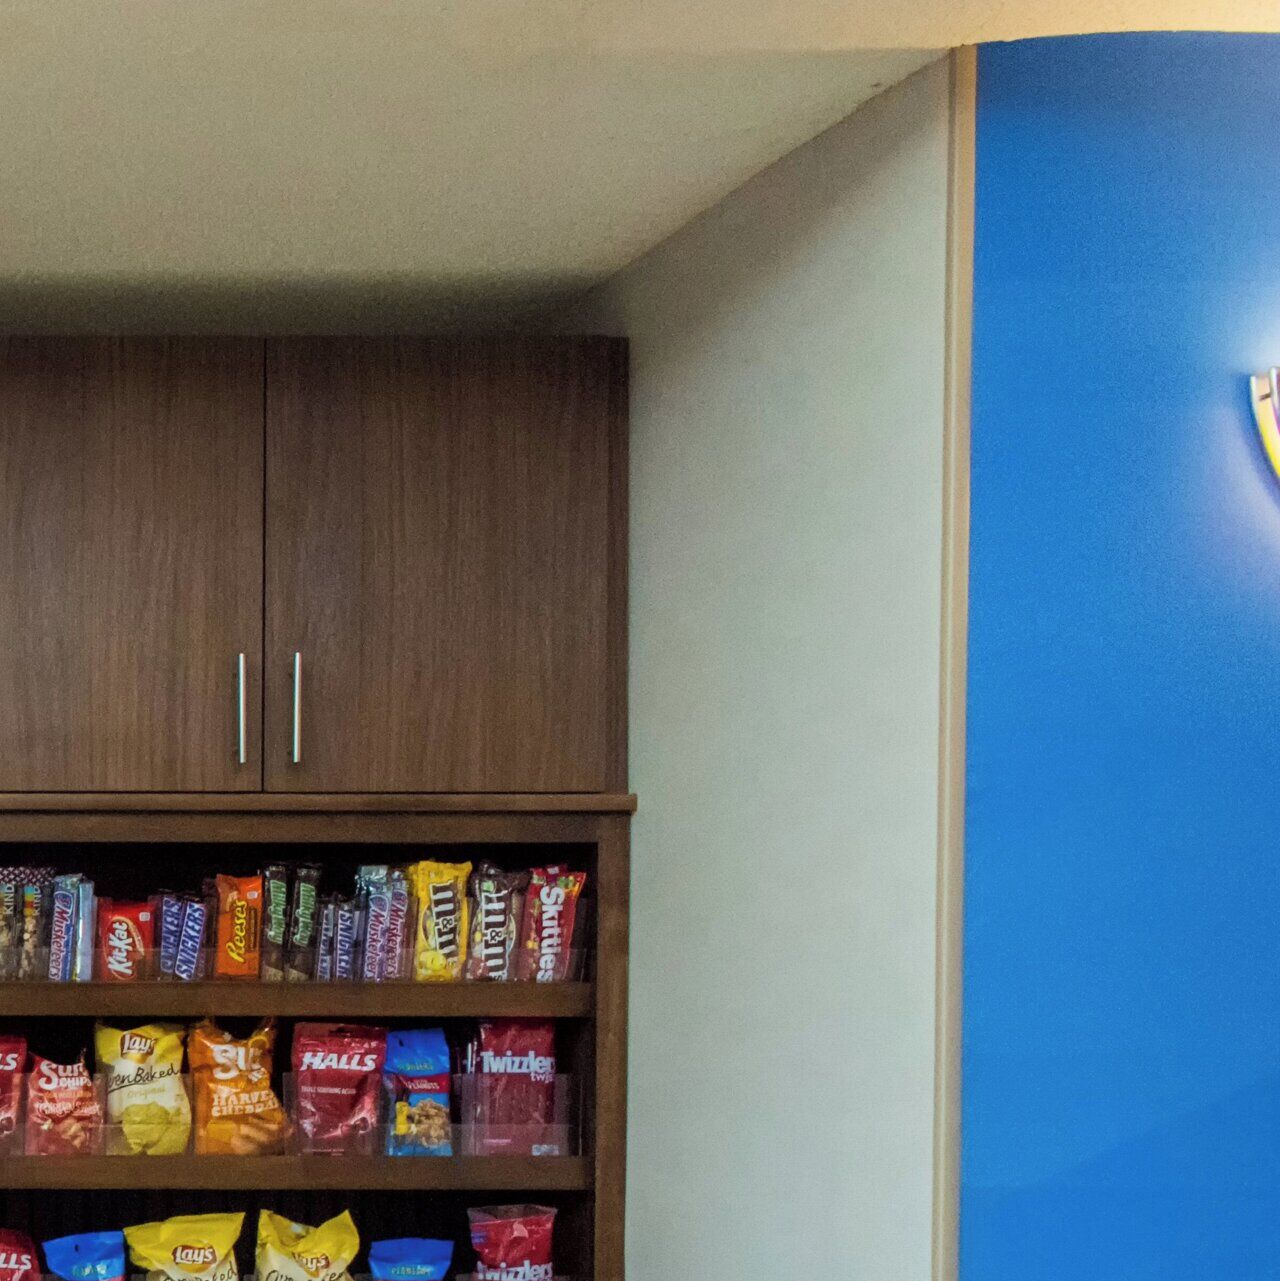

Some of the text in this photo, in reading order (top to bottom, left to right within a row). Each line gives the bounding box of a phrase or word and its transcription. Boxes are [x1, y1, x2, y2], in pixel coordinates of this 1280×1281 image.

[176, 902, 205, 981] SNICKERS
[537, 886, 566, 983] Skittles
[300, 1051, 377, 1071] HALLS
